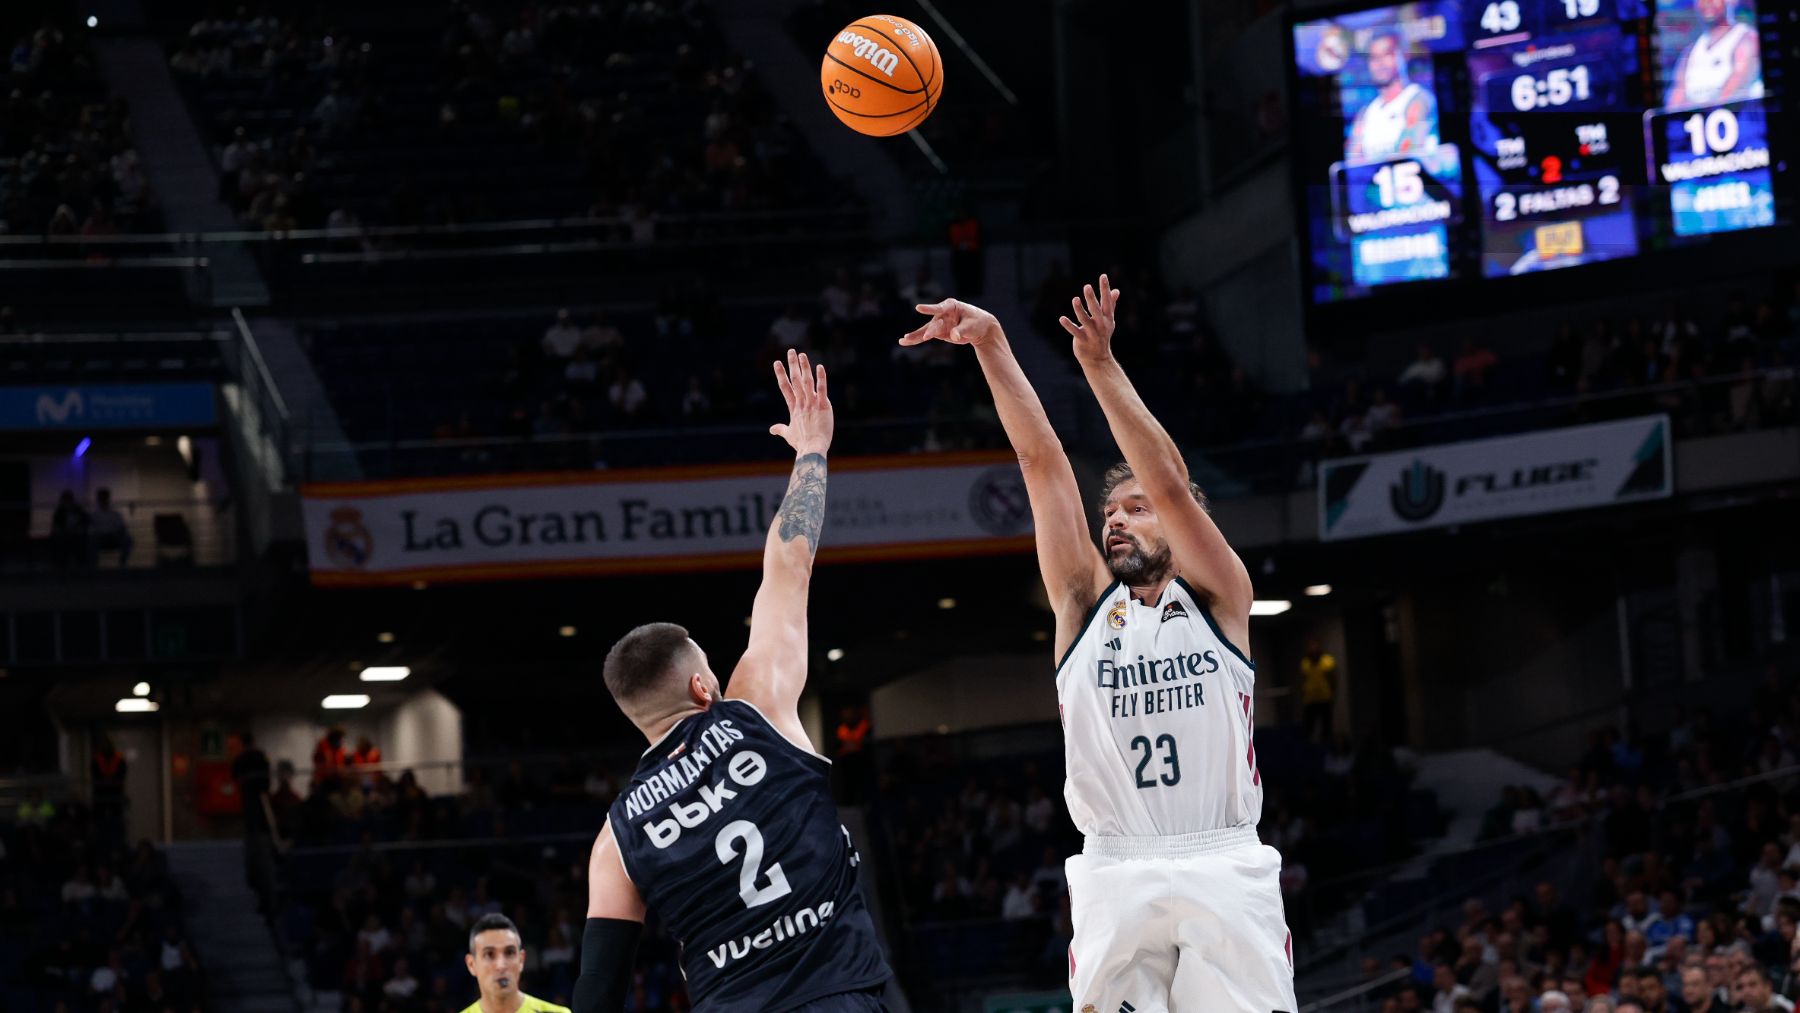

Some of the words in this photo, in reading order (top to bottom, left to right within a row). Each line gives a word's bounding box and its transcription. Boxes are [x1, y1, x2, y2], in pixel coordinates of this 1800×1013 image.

[1480, 0, 1521, 33] 43
[838, 30, 899, 77] Wilson
[833, 79, 861, 99] acb
[1511, 65, 1590, 111] 6:51
[1685, 109, 1739, 155] 10
[1373, 161, 1424, 206] 15
[1541, 155, 1562, 183] 2
[1496, 193, 1517, 221] 2
[1519, 185, 1594, 214] FALTAS
[1597, 175, 1620, 204] 2
[400, 509, 463, 552] La
[473, 505, 607, 547] Gran
[618, 492, 781, 543] Famil
[1097, 649, 1219, 690] Emirates
[1111, 692, 1138, 718] FLY
[1145, 682, 1205, 715] BETTER
[1130, 733, 1182, 788] 23
[643, 779, 738, 849] bbk
[715, 819, 792, 909] 2
[707, 901, 834, 969] vueling
